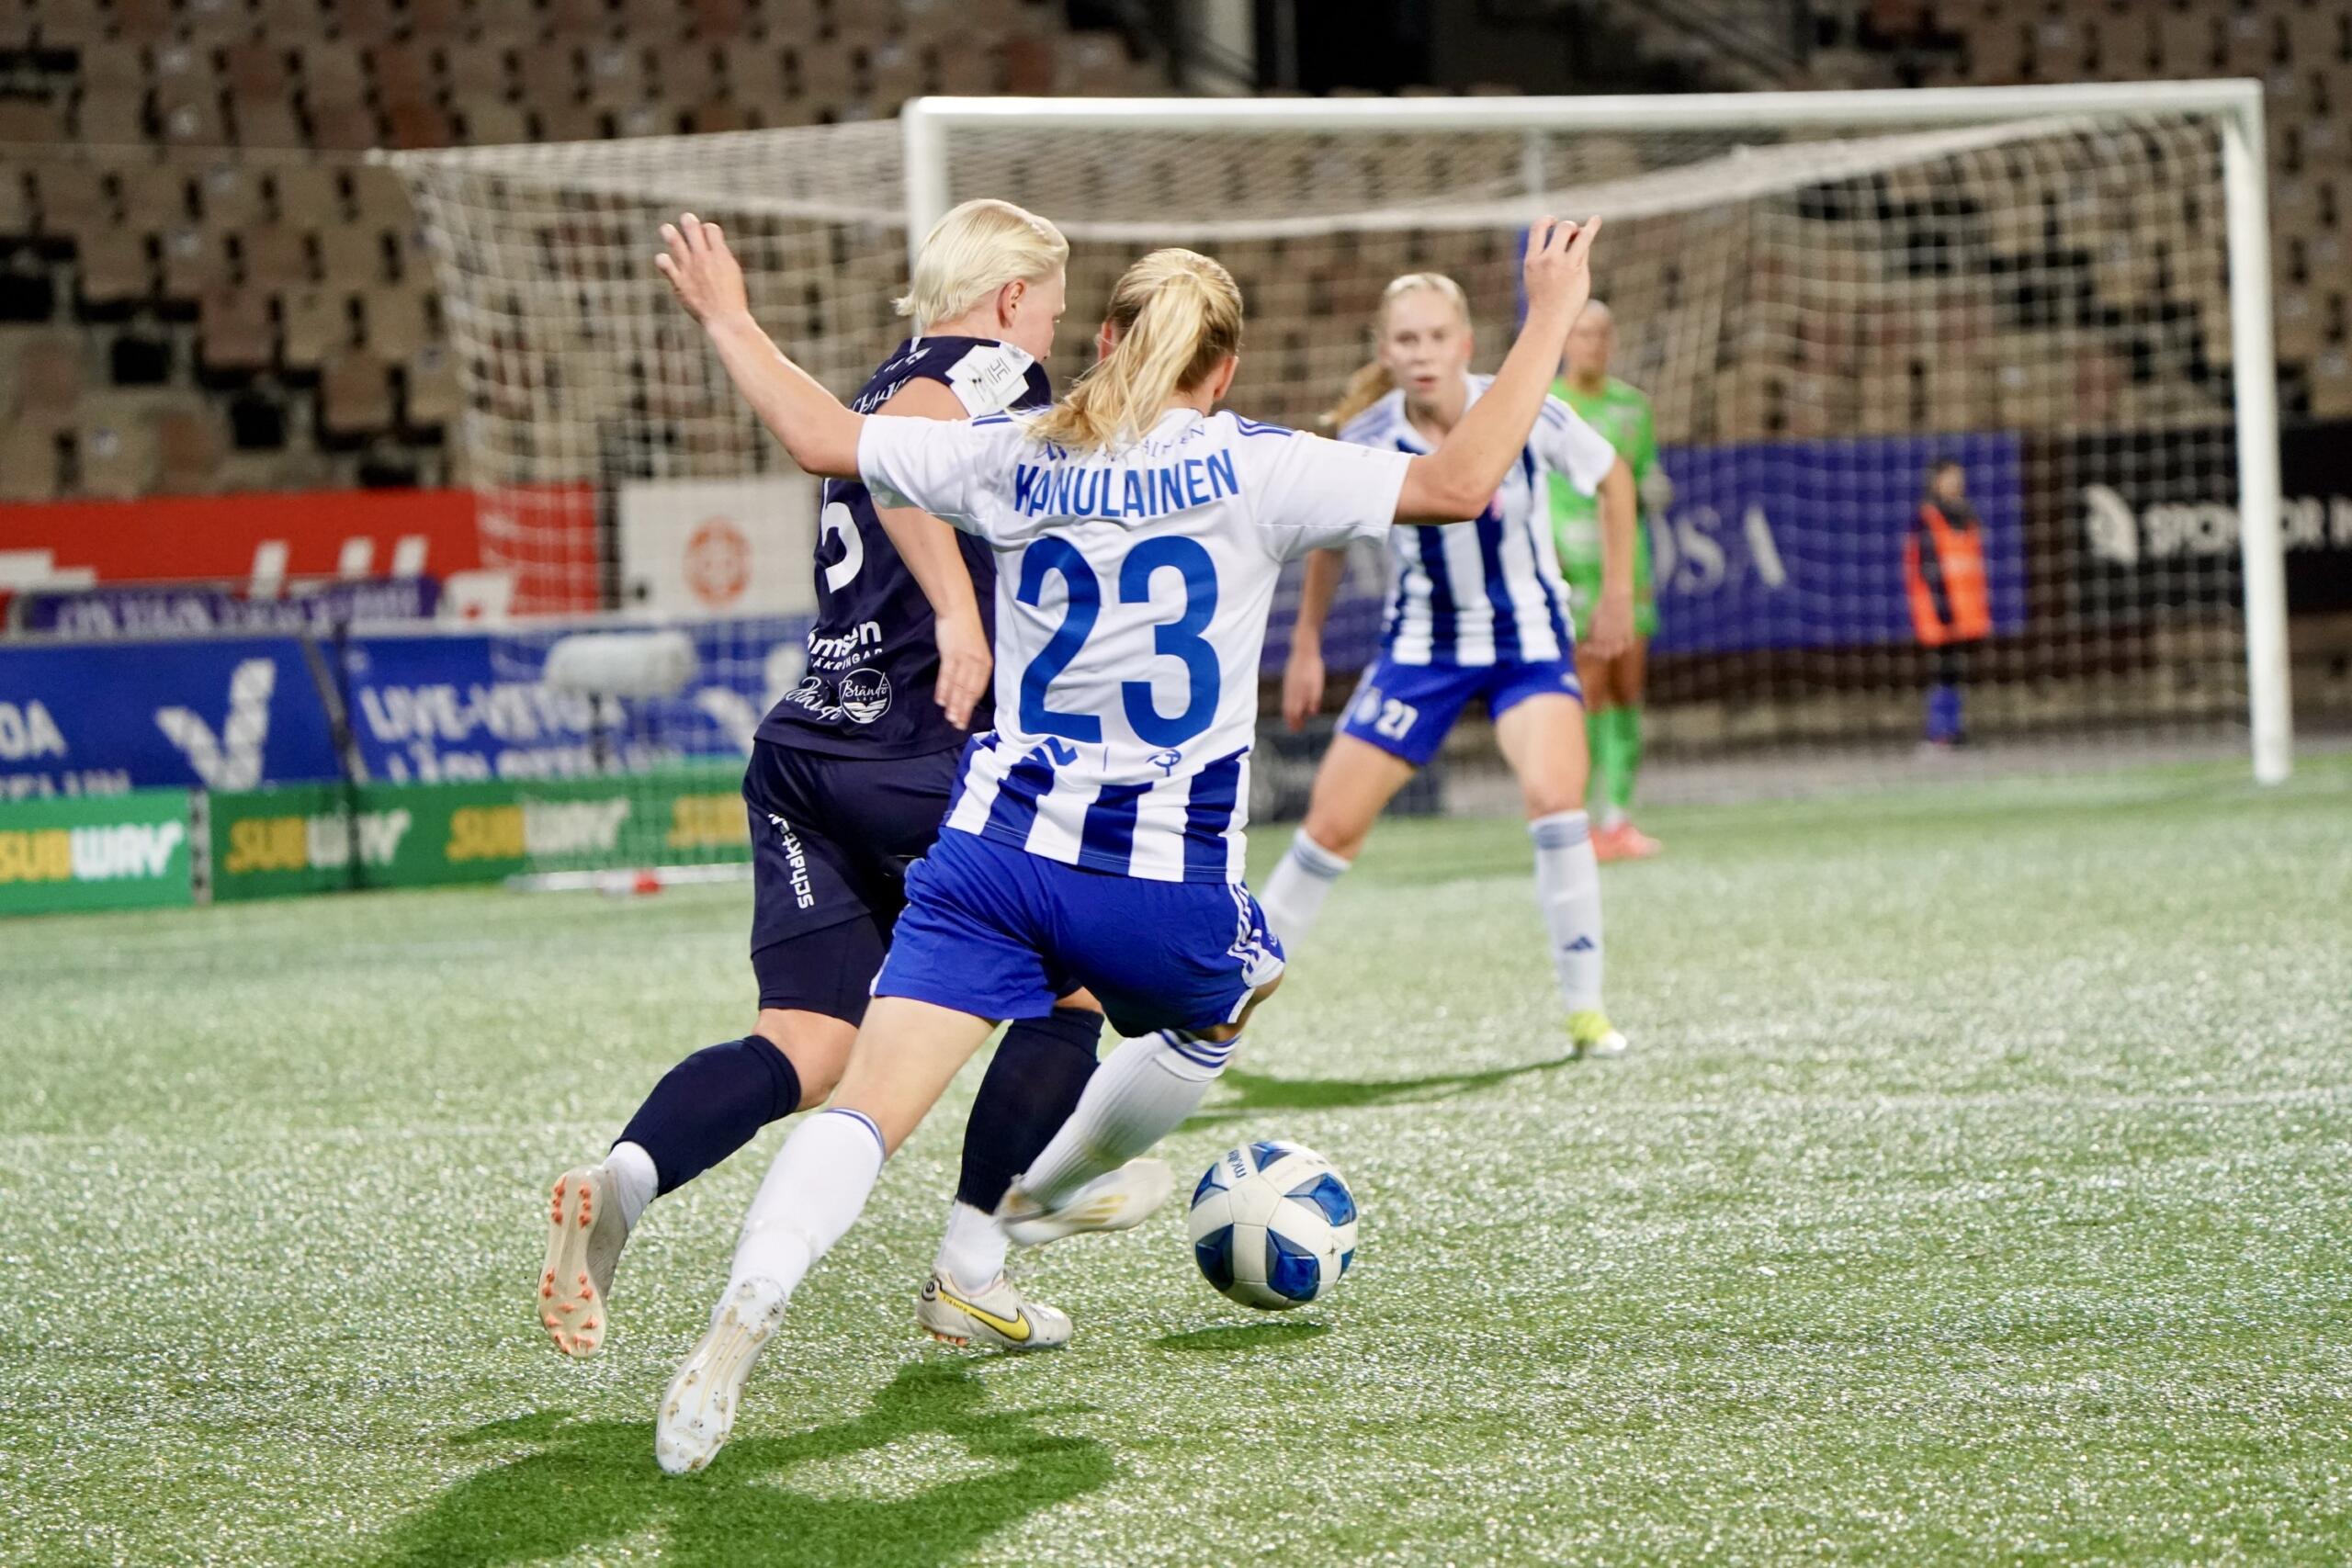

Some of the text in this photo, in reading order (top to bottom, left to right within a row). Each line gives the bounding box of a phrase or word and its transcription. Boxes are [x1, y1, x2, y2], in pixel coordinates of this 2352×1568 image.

[1014, 448, 1239, 518] KANULAINEN
[1016, 535, 1220, 748] 23
[1374, 697, 1419, 741] 27
